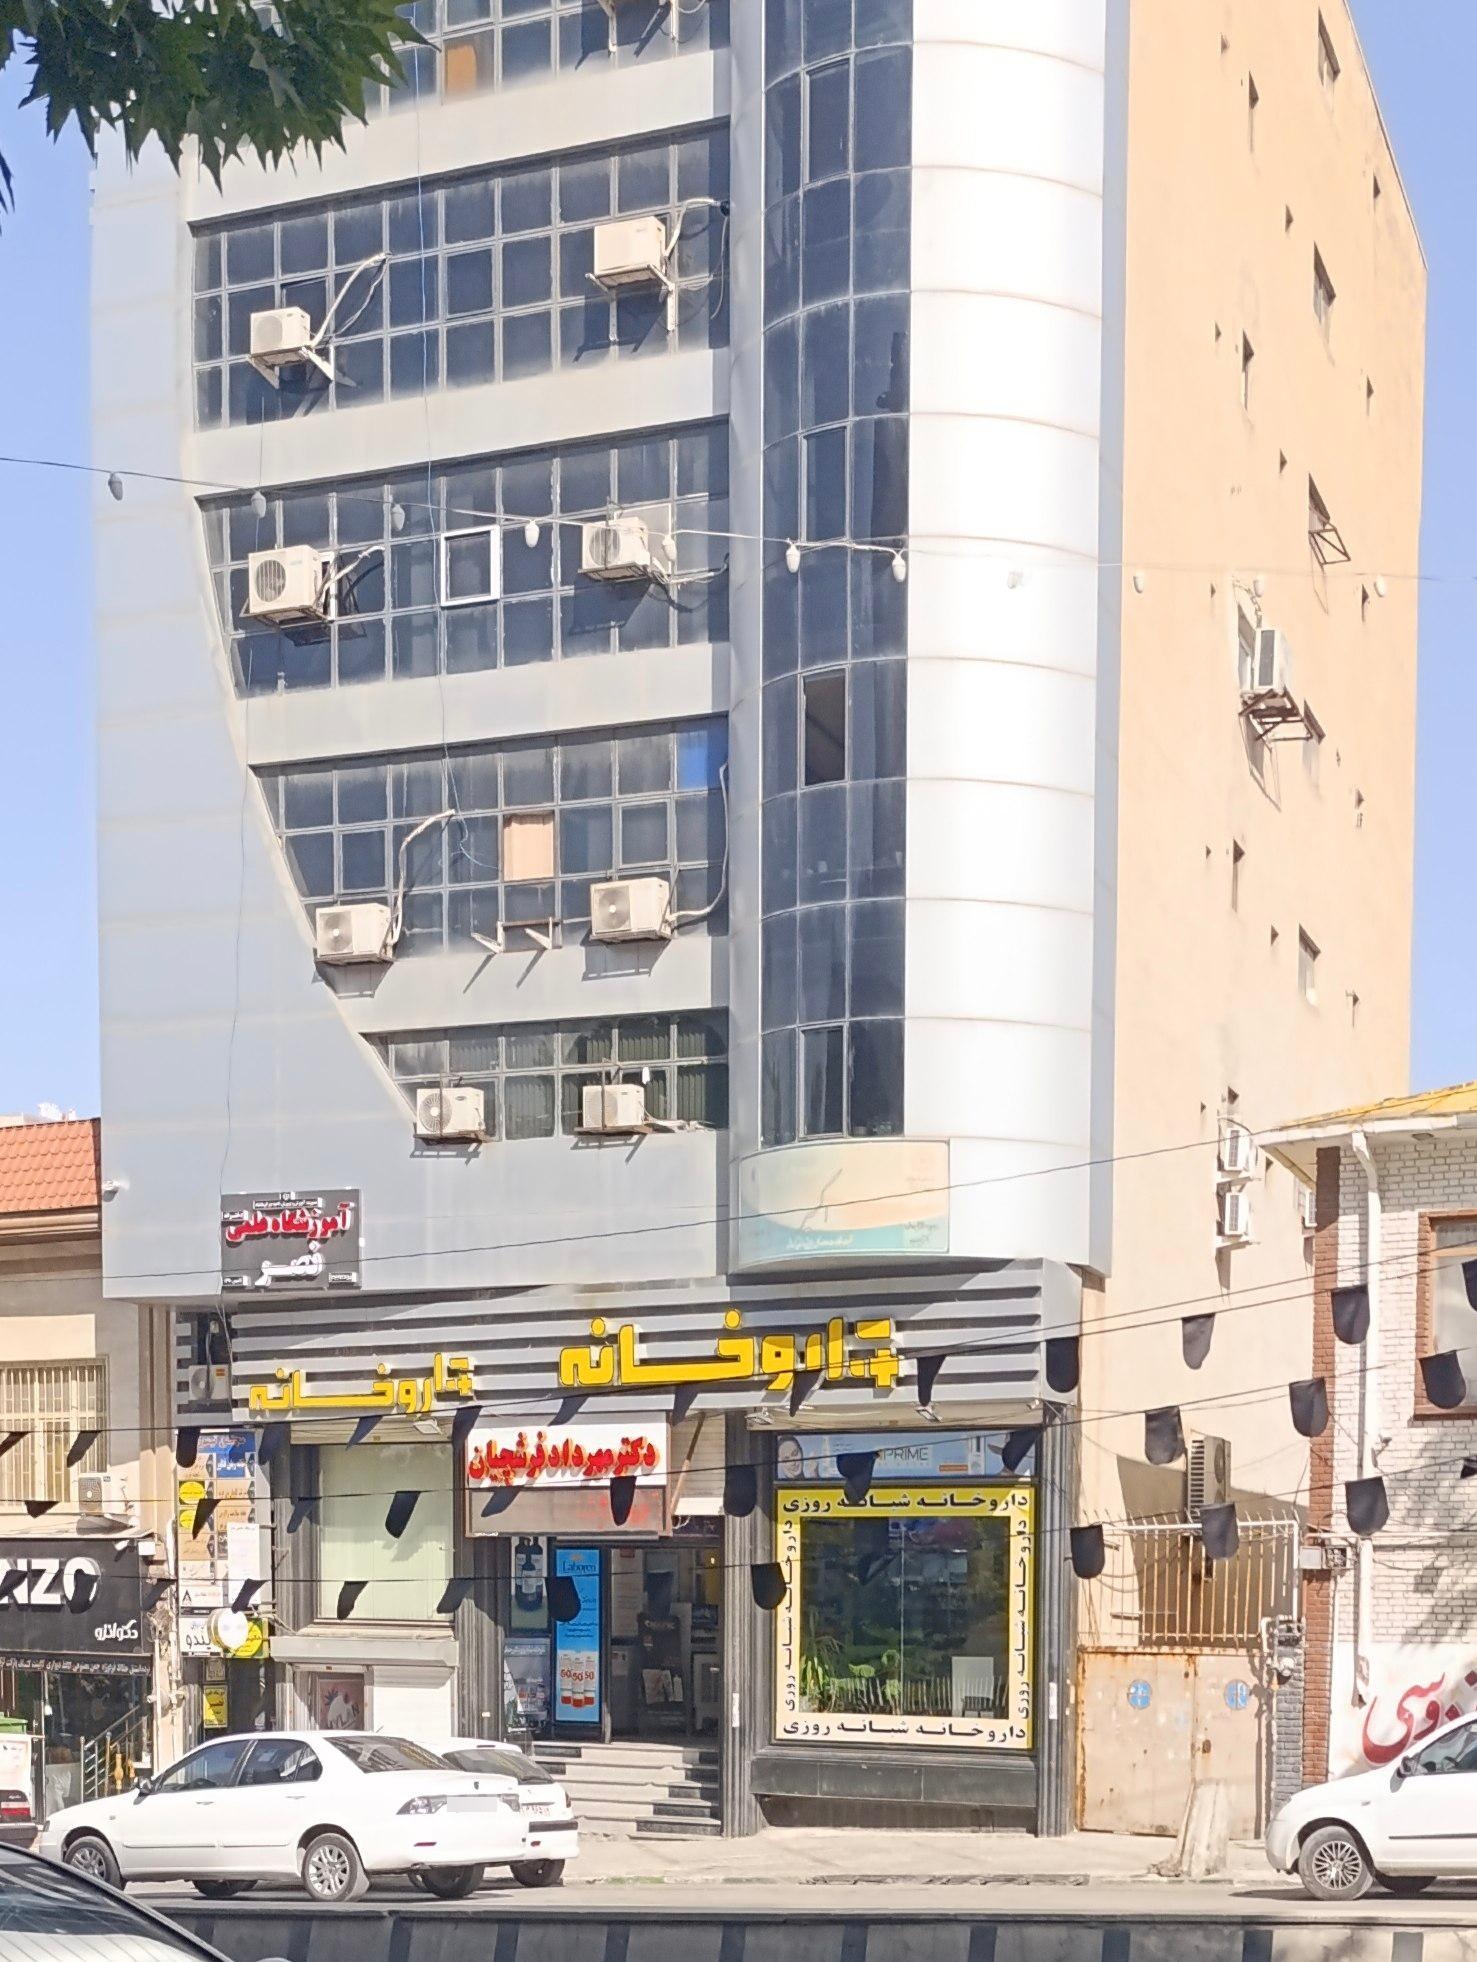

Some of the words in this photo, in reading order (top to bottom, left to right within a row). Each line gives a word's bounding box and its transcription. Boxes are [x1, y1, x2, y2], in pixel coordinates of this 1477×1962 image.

[469, 1431, 546, 1487] فرشچیان
[548, 1437, 614, 1477] مهرداد
[614, 1436, 657, 1475] دکتر
[783, 1499, 831, 1513] روزی
[916, 1494, 1028, 1512] داروخانه
[1017, 1682, 1030, 1720] روزی
[783, 1719, 831, 1735] روزی
[836, 1720, 909, 1735] شبانه
[915, 1721, 1026, 1742] داروخانه
